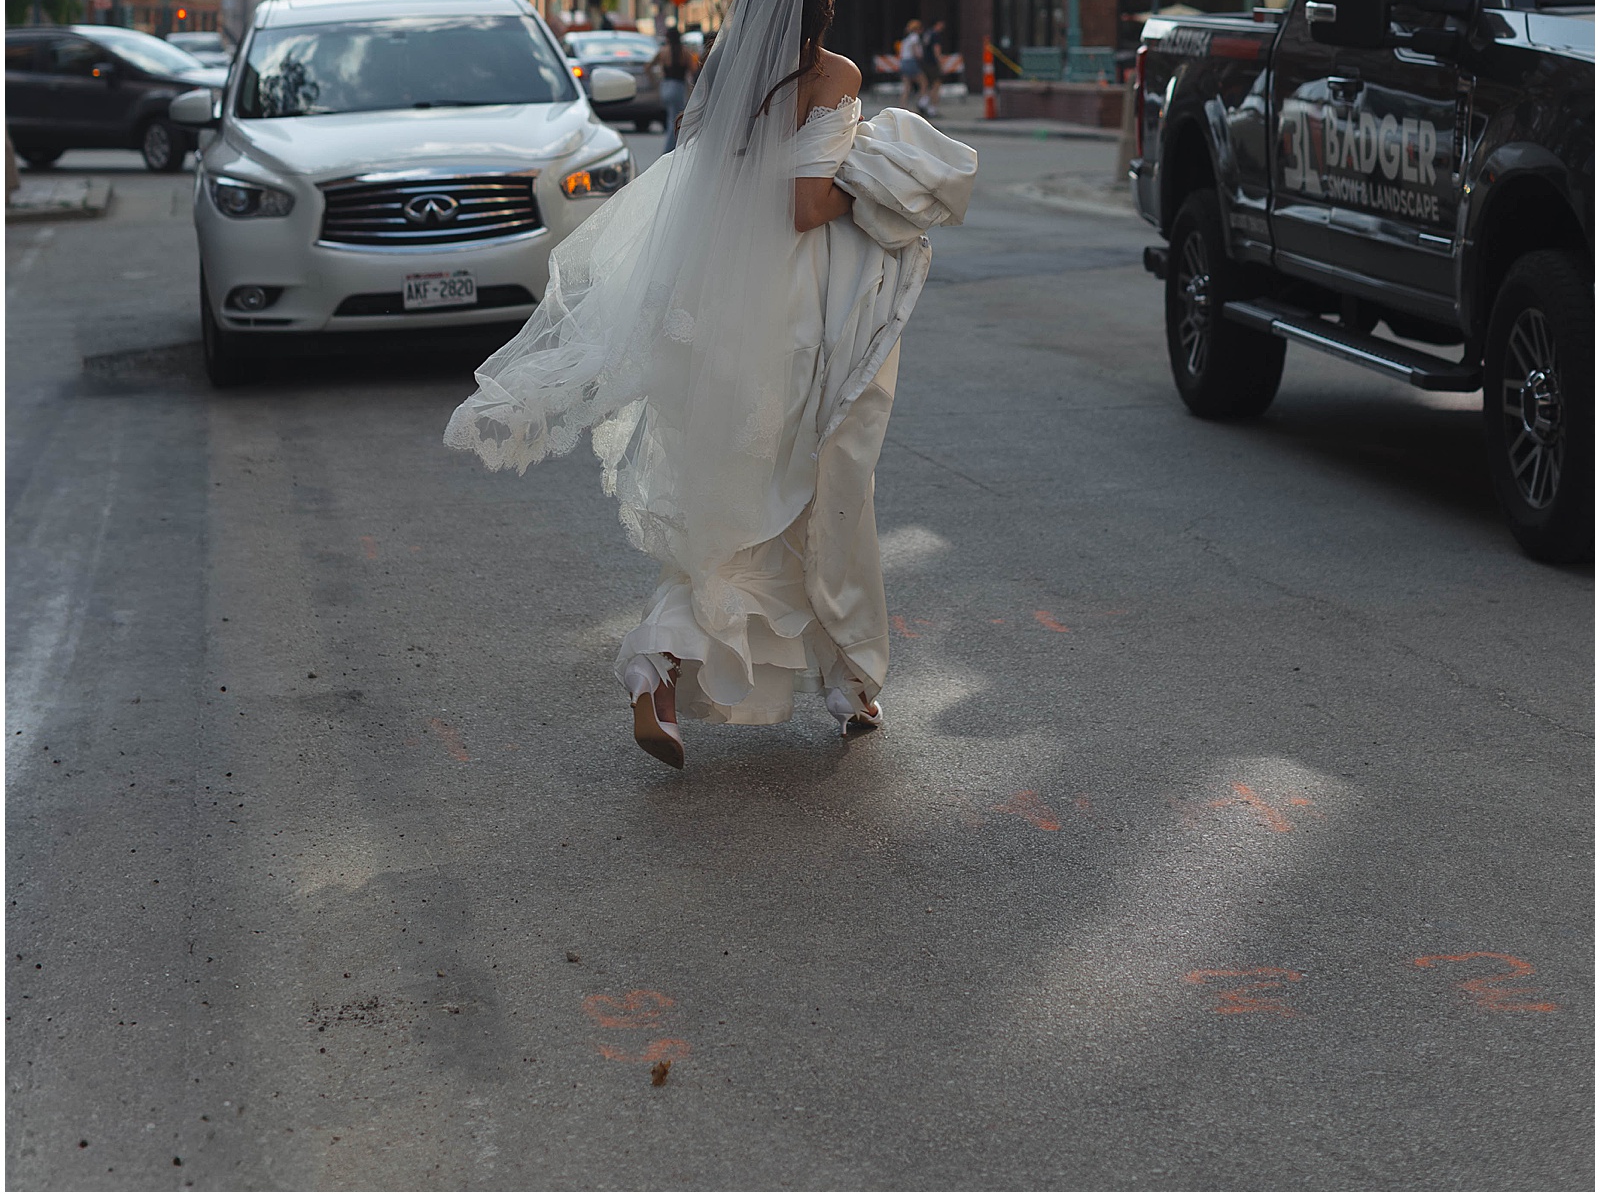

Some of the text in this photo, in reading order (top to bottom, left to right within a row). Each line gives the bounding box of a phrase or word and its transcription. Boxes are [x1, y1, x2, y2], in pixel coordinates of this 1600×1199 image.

[1325, 106, 1437, 186] BADGER
[1328, 174, 1360, 203] SNOW
[1370, 182, 1440, 221] LANDSCAPE
